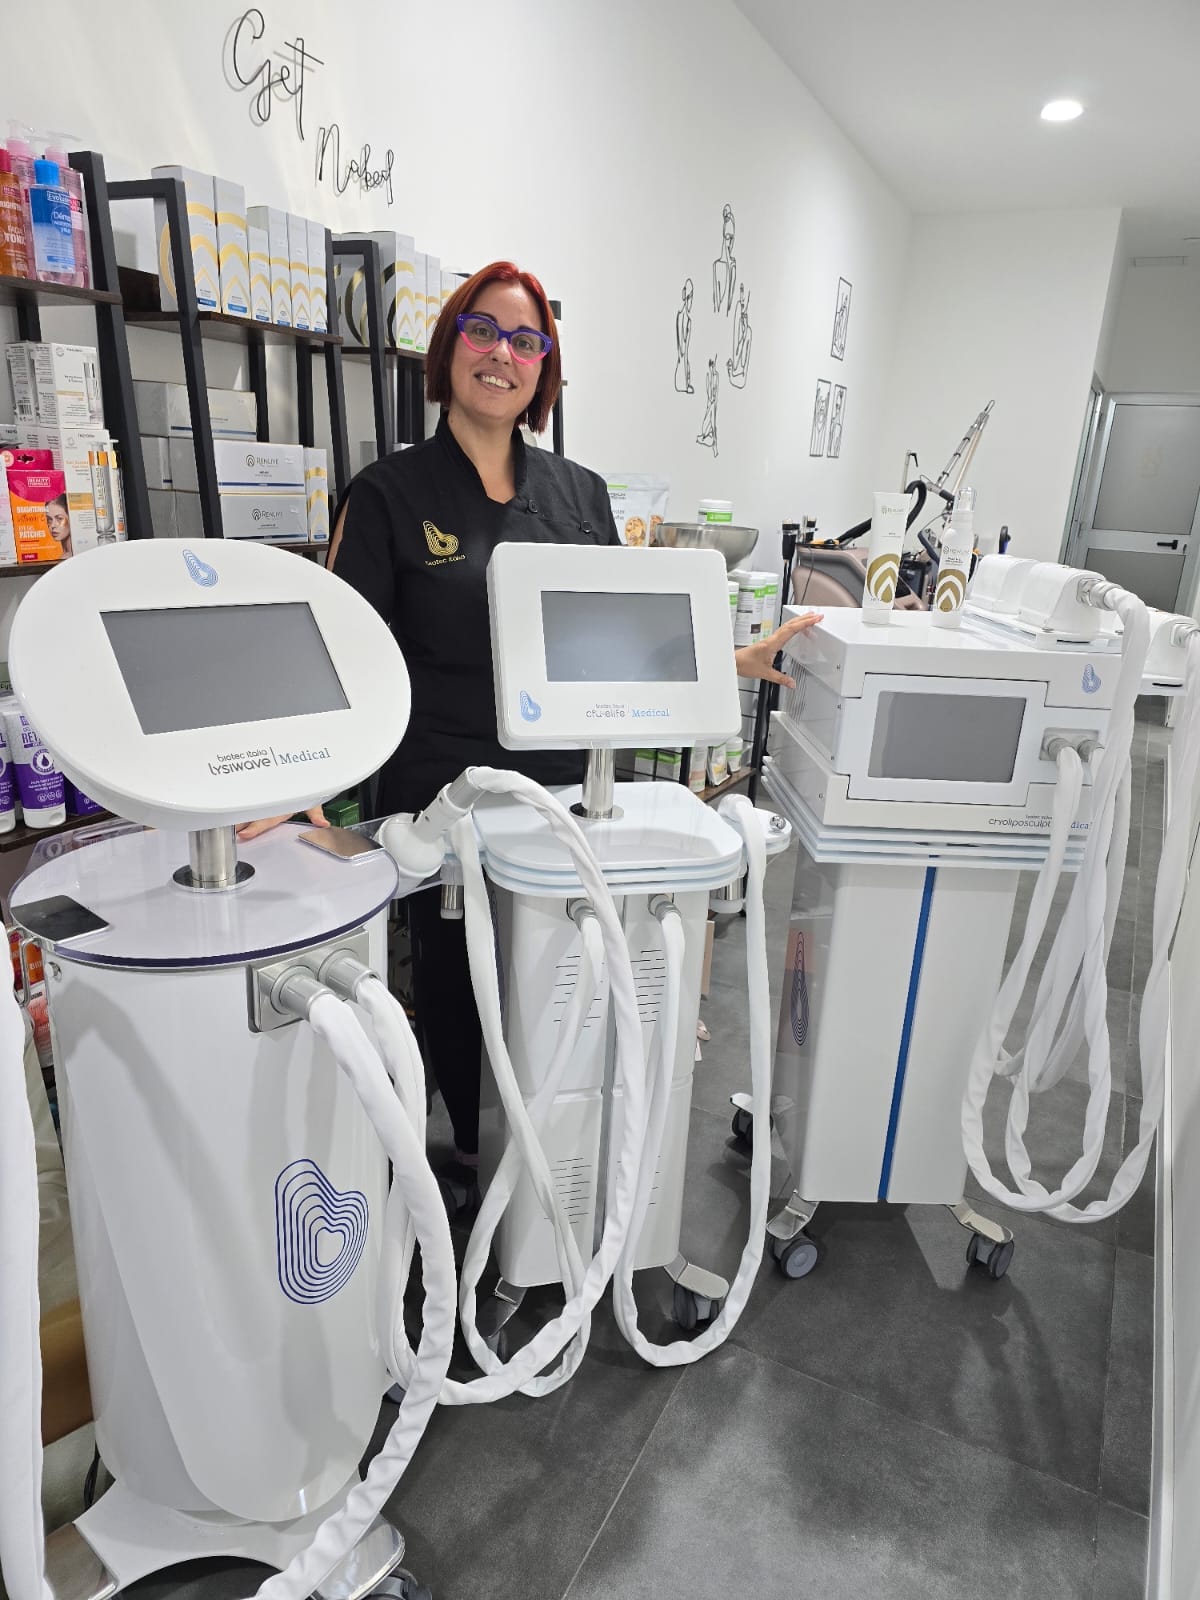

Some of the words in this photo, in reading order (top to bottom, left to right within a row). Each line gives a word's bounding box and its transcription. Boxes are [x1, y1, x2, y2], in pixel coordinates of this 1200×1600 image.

[233, 8, 325, 141] Get
[631, 708, 670, 718] Medical
[217, 751, 246, 762] biotec
[278, 747, 332, 765] Medical
